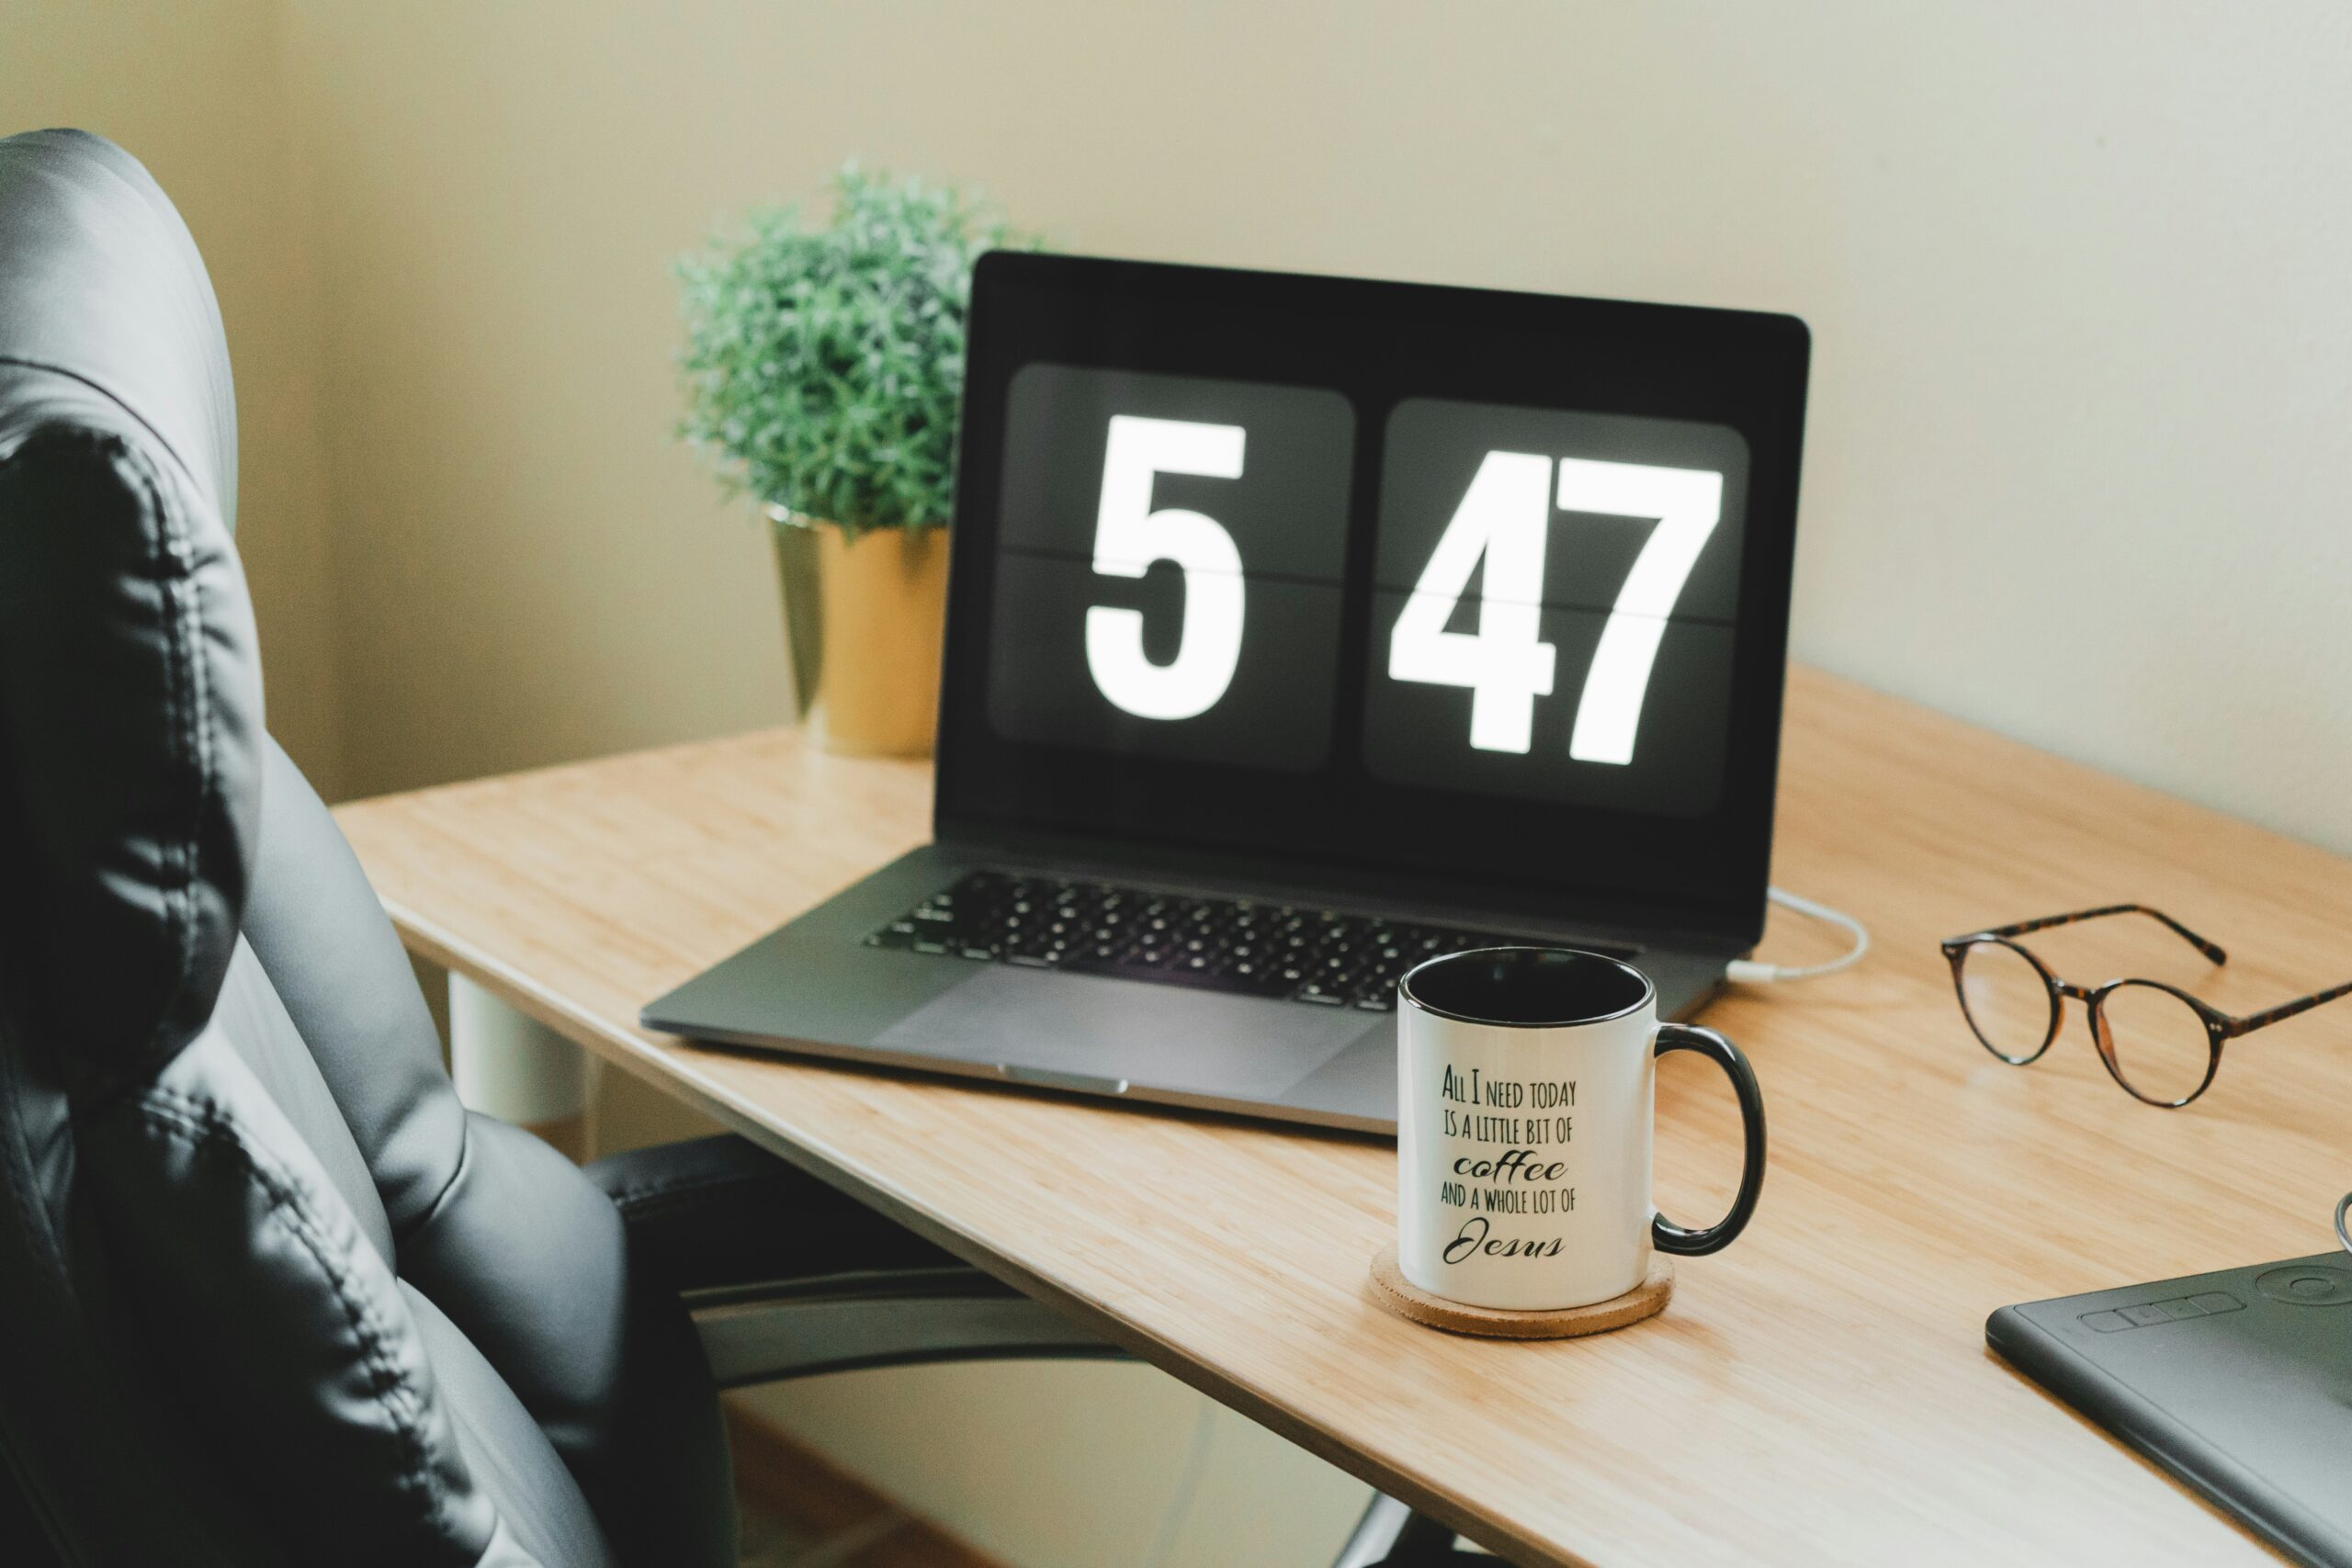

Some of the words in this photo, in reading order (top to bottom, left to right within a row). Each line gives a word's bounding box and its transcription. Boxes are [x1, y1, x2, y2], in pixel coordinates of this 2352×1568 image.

[1085, 414, 1247, 720] 5
[1388, 449, 1724, 766] 47
[1442, 1063, 1467, 1103] ALL
[1471, 1067, 1481, 1105] I
[1486, 1080, 1523, 1109] NEED
[1529, 1080, 1577, 1110] TODAY
[1443, 1109, 1457, 1137] IS
[1462, 1113, 1472, 1140] A
[1476, 1114, 1520, 1145] LITTLE
[1526, 1118, 1551, 1145] BIT
[1555, 1116, 1573, 1144] OF
[1453, 1149, 1569, 1185] coffee
[1441, 1180, 1466, 1208] AND
[1470, 1187, 1479, 1211] A
[1484, 1188, 1528, 1214] WHOLE
[1533, 1189, 1556, 1214] LOT
[1561, 1188, 1576, 1213] OF
[1442, 1216, 1566, 1265] Jesus
